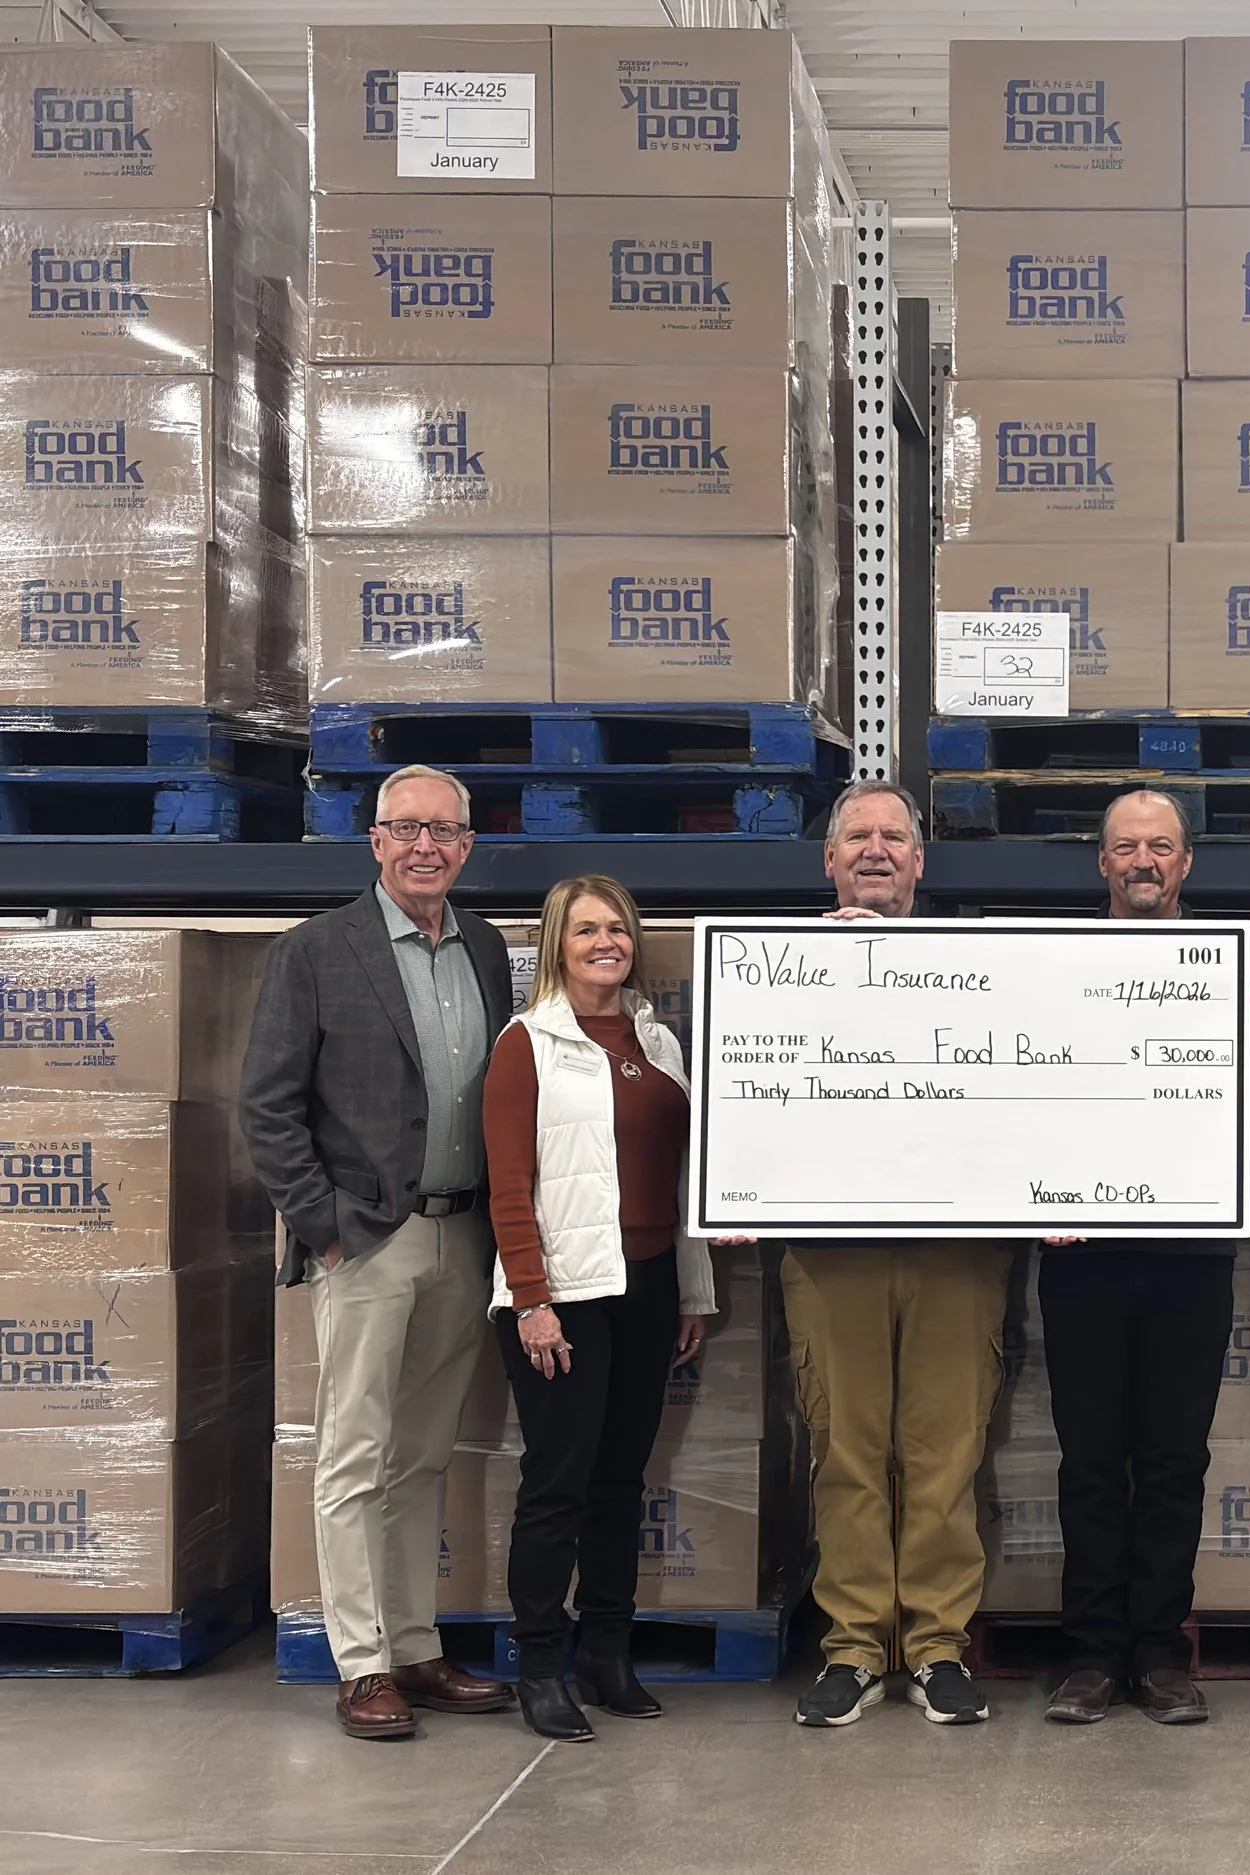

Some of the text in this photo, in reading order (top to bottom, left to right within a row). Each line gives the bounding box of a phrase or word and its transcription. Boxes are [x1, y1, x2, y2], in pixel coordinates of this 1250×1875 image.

[60, 87, 122, 97] KANSAS
[424, 82, 507, 98] F4K-2425
[1004, 79, 1105, 118] food
[1033, 79, 1094, 89] KANSAS
[30, 87, 133, 124] food
[619, 85, 738, 116] bank
[34, 123, 152, 152] bank
[638, 113, 741, 153] food
[1006, 115, 1123, 145] bank
[649, 141, 711, 152] KANSAS
[431, 152, 499, 172] January
[609, 239, 712, 278] food
[638, 239, 700, 250] KANSAS
[28, 247, 130, 284] food
[372, 252, 492, 283] bank
[1006, 254, 1107, 292] food
[1035, 255, 1096, 264] KANSAS
[391, 280, 495, 319] food
[612, 275, 731, 306] bank
[1009, 290, 1125, 320] bank
[402, 308, 465, 319] KANSAS
[608, 403, 711, 442] food
[637, 403, 699, 414] KANSAS
[22, 419, 126, 457] food
[52, 420, 114, 429] KANSAS
[418, 412, 466, 446] od
[1024, 421, 1084, 431] KANSAS
[610, 439, 730, 470] bank
[995, 421, 1096, 459] food
[26, 455, 144, 484] bank
[426, 447, 485, 474] nk
[998, 457, 1114, 486] bank
[48, 579, 110, 589] KANSAS
[389, 581, 451, 590] KANSAS
[608, 576, 711, 614] food
[638, 576, 700, 586] KANSAS
[1017, 588, 1077, 596] KANSAS
[18, 579, 122, 616] food
[359, 580, 463, 618] food
[21, 614, 140, 644] bank
[611, 612, 730, 642] bank
[962, 622, 1042, 637] F4K-2425
[1000, 655, 1033, 677] 32
[968, 692, 1034, 710] January
[720, 935, 992, 991] ProValue Insurance
[1178, 948, 1222, 964] 1001
[1084, 980, 1211, 1008] DATE 1/16/2026
[722, 1035, 808, 1046] PAY TO THE
[722, 1052, 776, 1064] ORDER
[778, 1052, 799, 1064] OF
[821, 1035, 895, 1063] Kansas
[935, 1028, 993, 1066] Food
[1016, 1033, 1072, 1065] Bank
[1131, 1046, 1140, 1060] $
[732, 1076, 1223, 1106] Thirty Thousand Dollars DOLLARS
[18, 1142, 80, 1150] KANSAS
[721, 1192, 757, 1202] MEMO
[1030, 1180, 1083, 1204] Kansas
[19, 1319, 82, 1329] KANSAS
[0, 1488, 86, 1527] ood
[12, 1488, 75, 1498] KANSAS
[640, 1523, 695, 1551] nk
